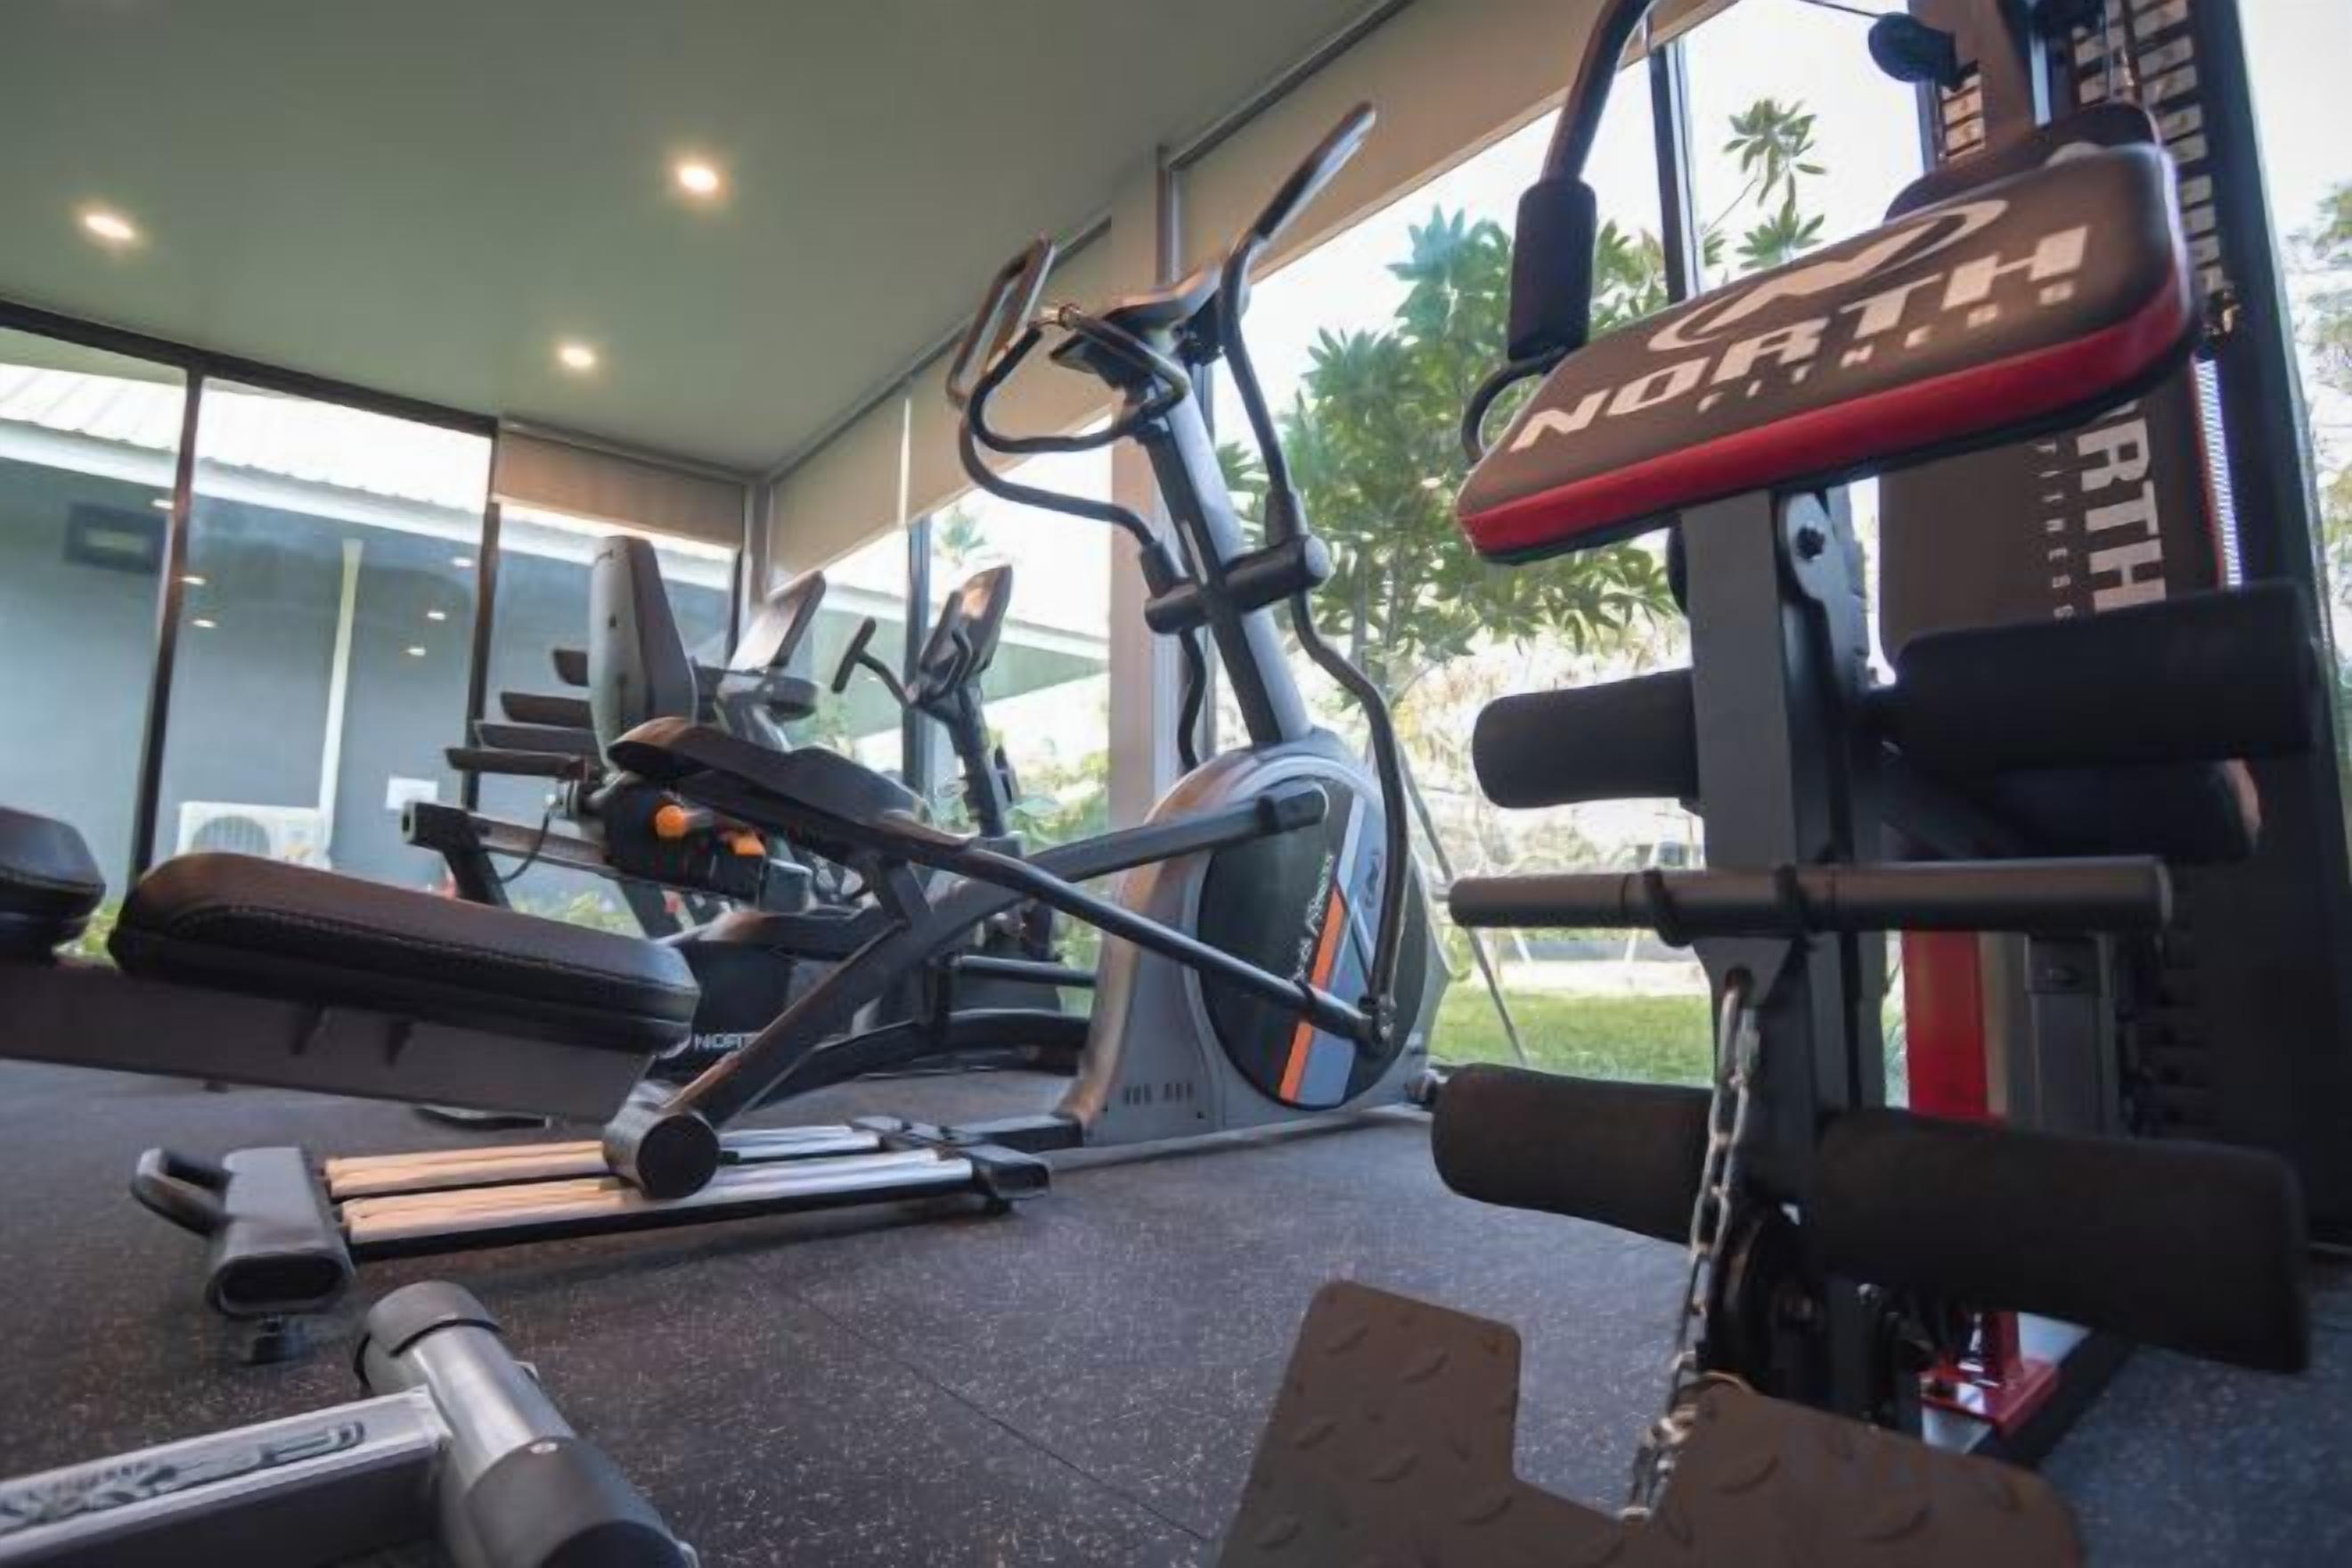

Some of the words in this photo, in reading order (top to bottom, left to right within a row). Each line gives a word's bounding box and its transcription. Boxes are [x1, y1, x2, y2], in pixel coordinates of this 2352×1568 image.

[1511, 225, 2087, 453] NORTH
[2076, 400, 2167, 613] RTH
[695, 1033, 760, 1050] NOR
